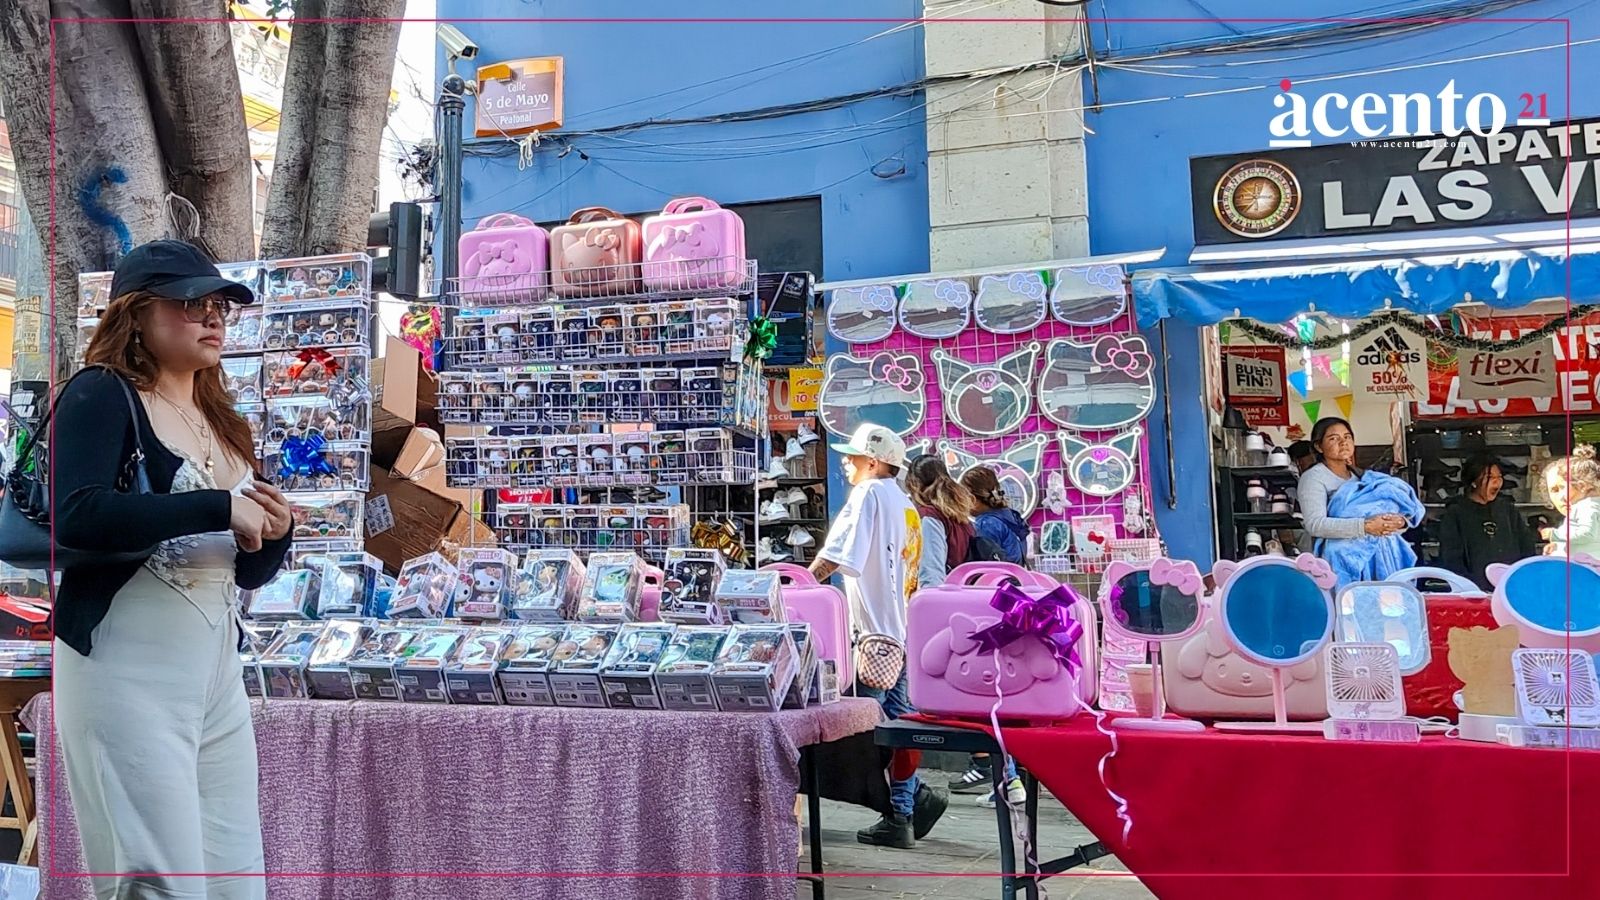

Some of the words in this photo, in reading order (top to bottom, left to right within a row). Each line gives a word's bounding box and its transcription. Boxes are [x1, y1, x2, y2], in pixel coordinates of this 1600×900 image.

[507, 81, 526, 93] Calle
[485, 98, 493, 110] 5
[496, 95, 512, 109] de
[515, 93, 549, 108] Mayo
[499, 111, 532, 126] Peatonal
[1322, 169, 1494, 230] LAS
[1235, 363, 1273, 377] BUEN
[1469, 350, 1542, 376] flexi
[1372, 370, 1408, 385] 50%
